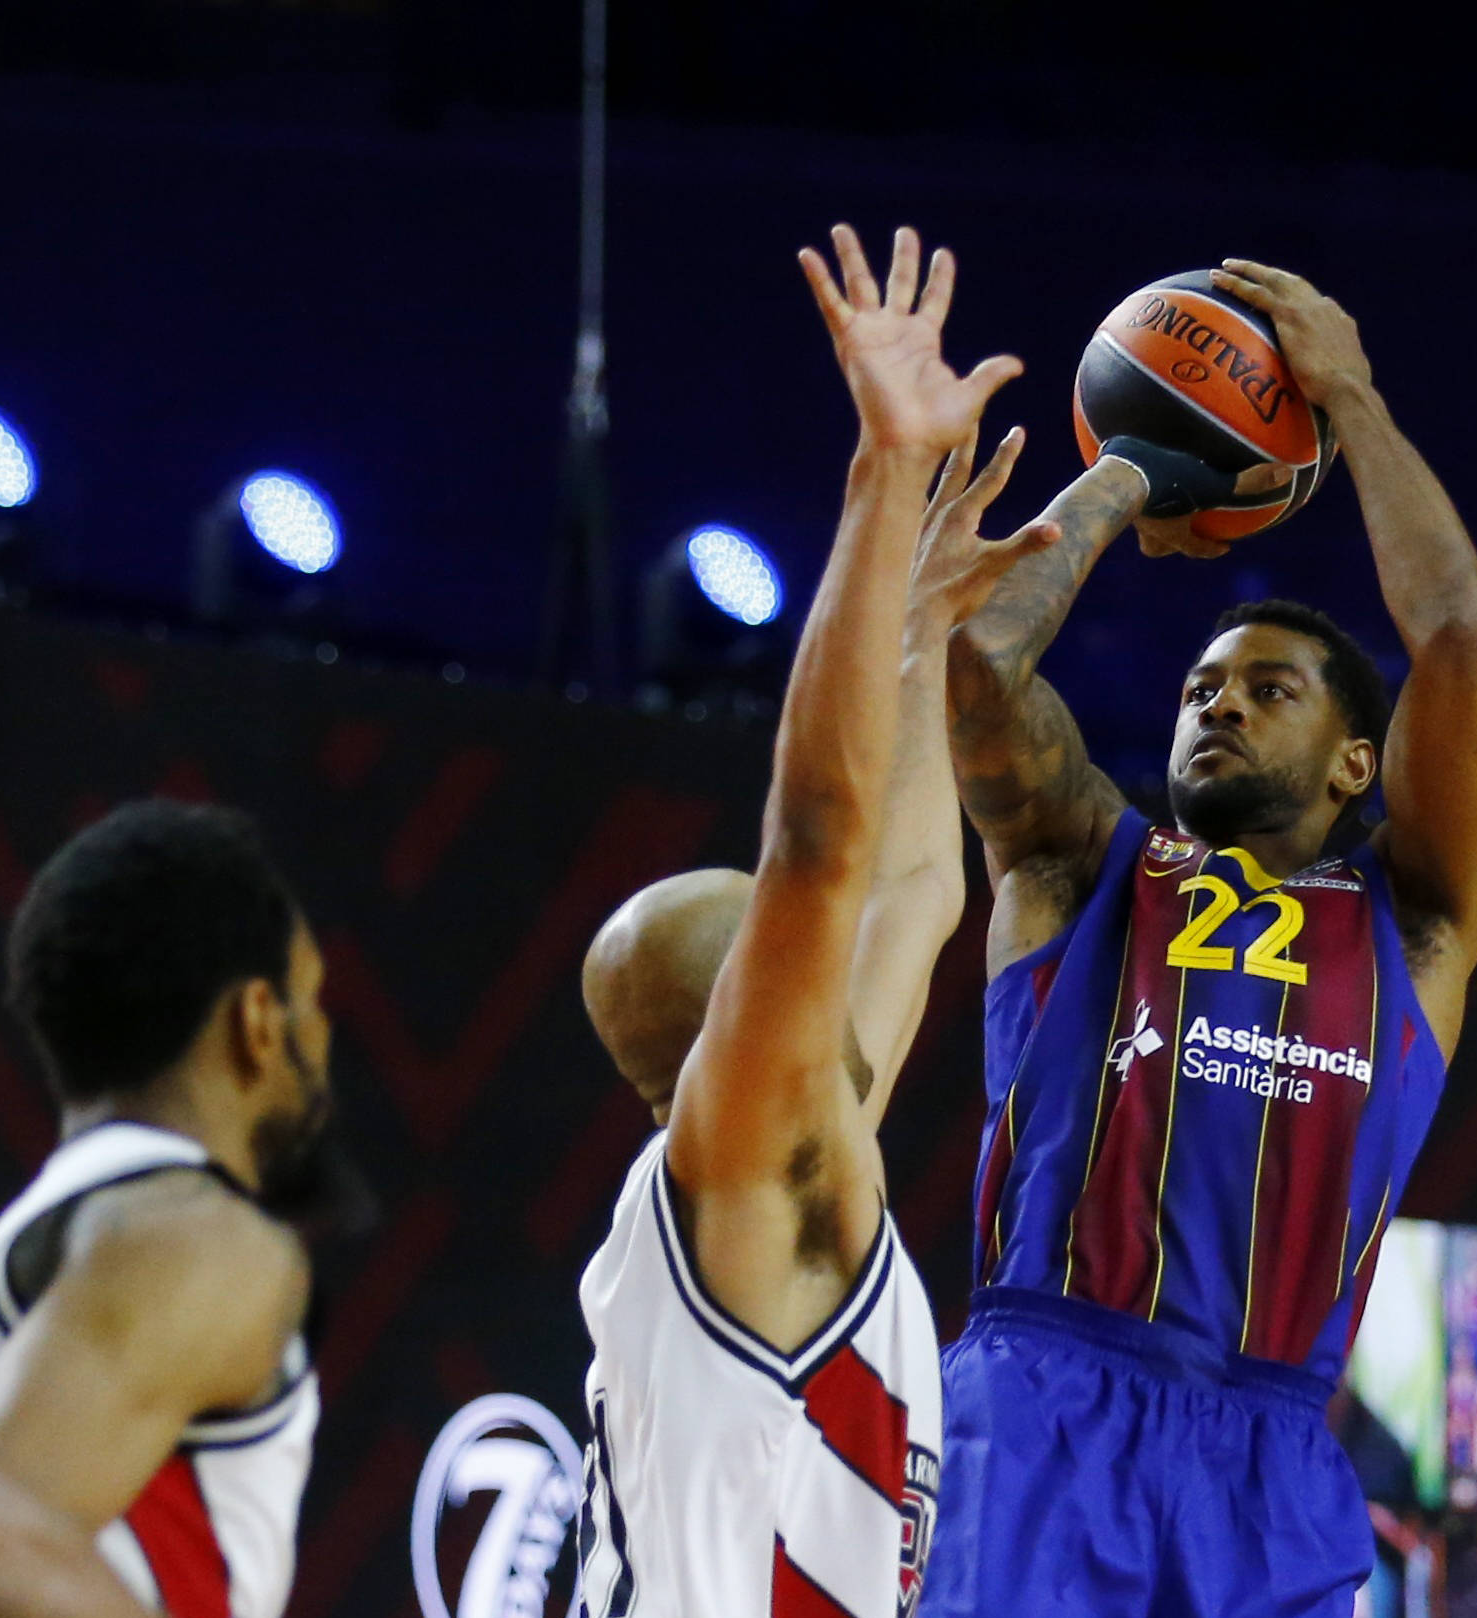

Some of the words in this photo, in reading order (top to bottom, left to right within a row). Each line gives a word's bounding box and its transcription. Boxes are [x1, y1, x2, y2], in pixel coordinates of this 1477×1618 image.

[1127, 296, 1294, 425] SPALDING
[1167, 875, 1308, 985] 22
[1182, 1049, 1313, 1105] Sanitària
[1184, 1016, 1374, 1085] Assistència
